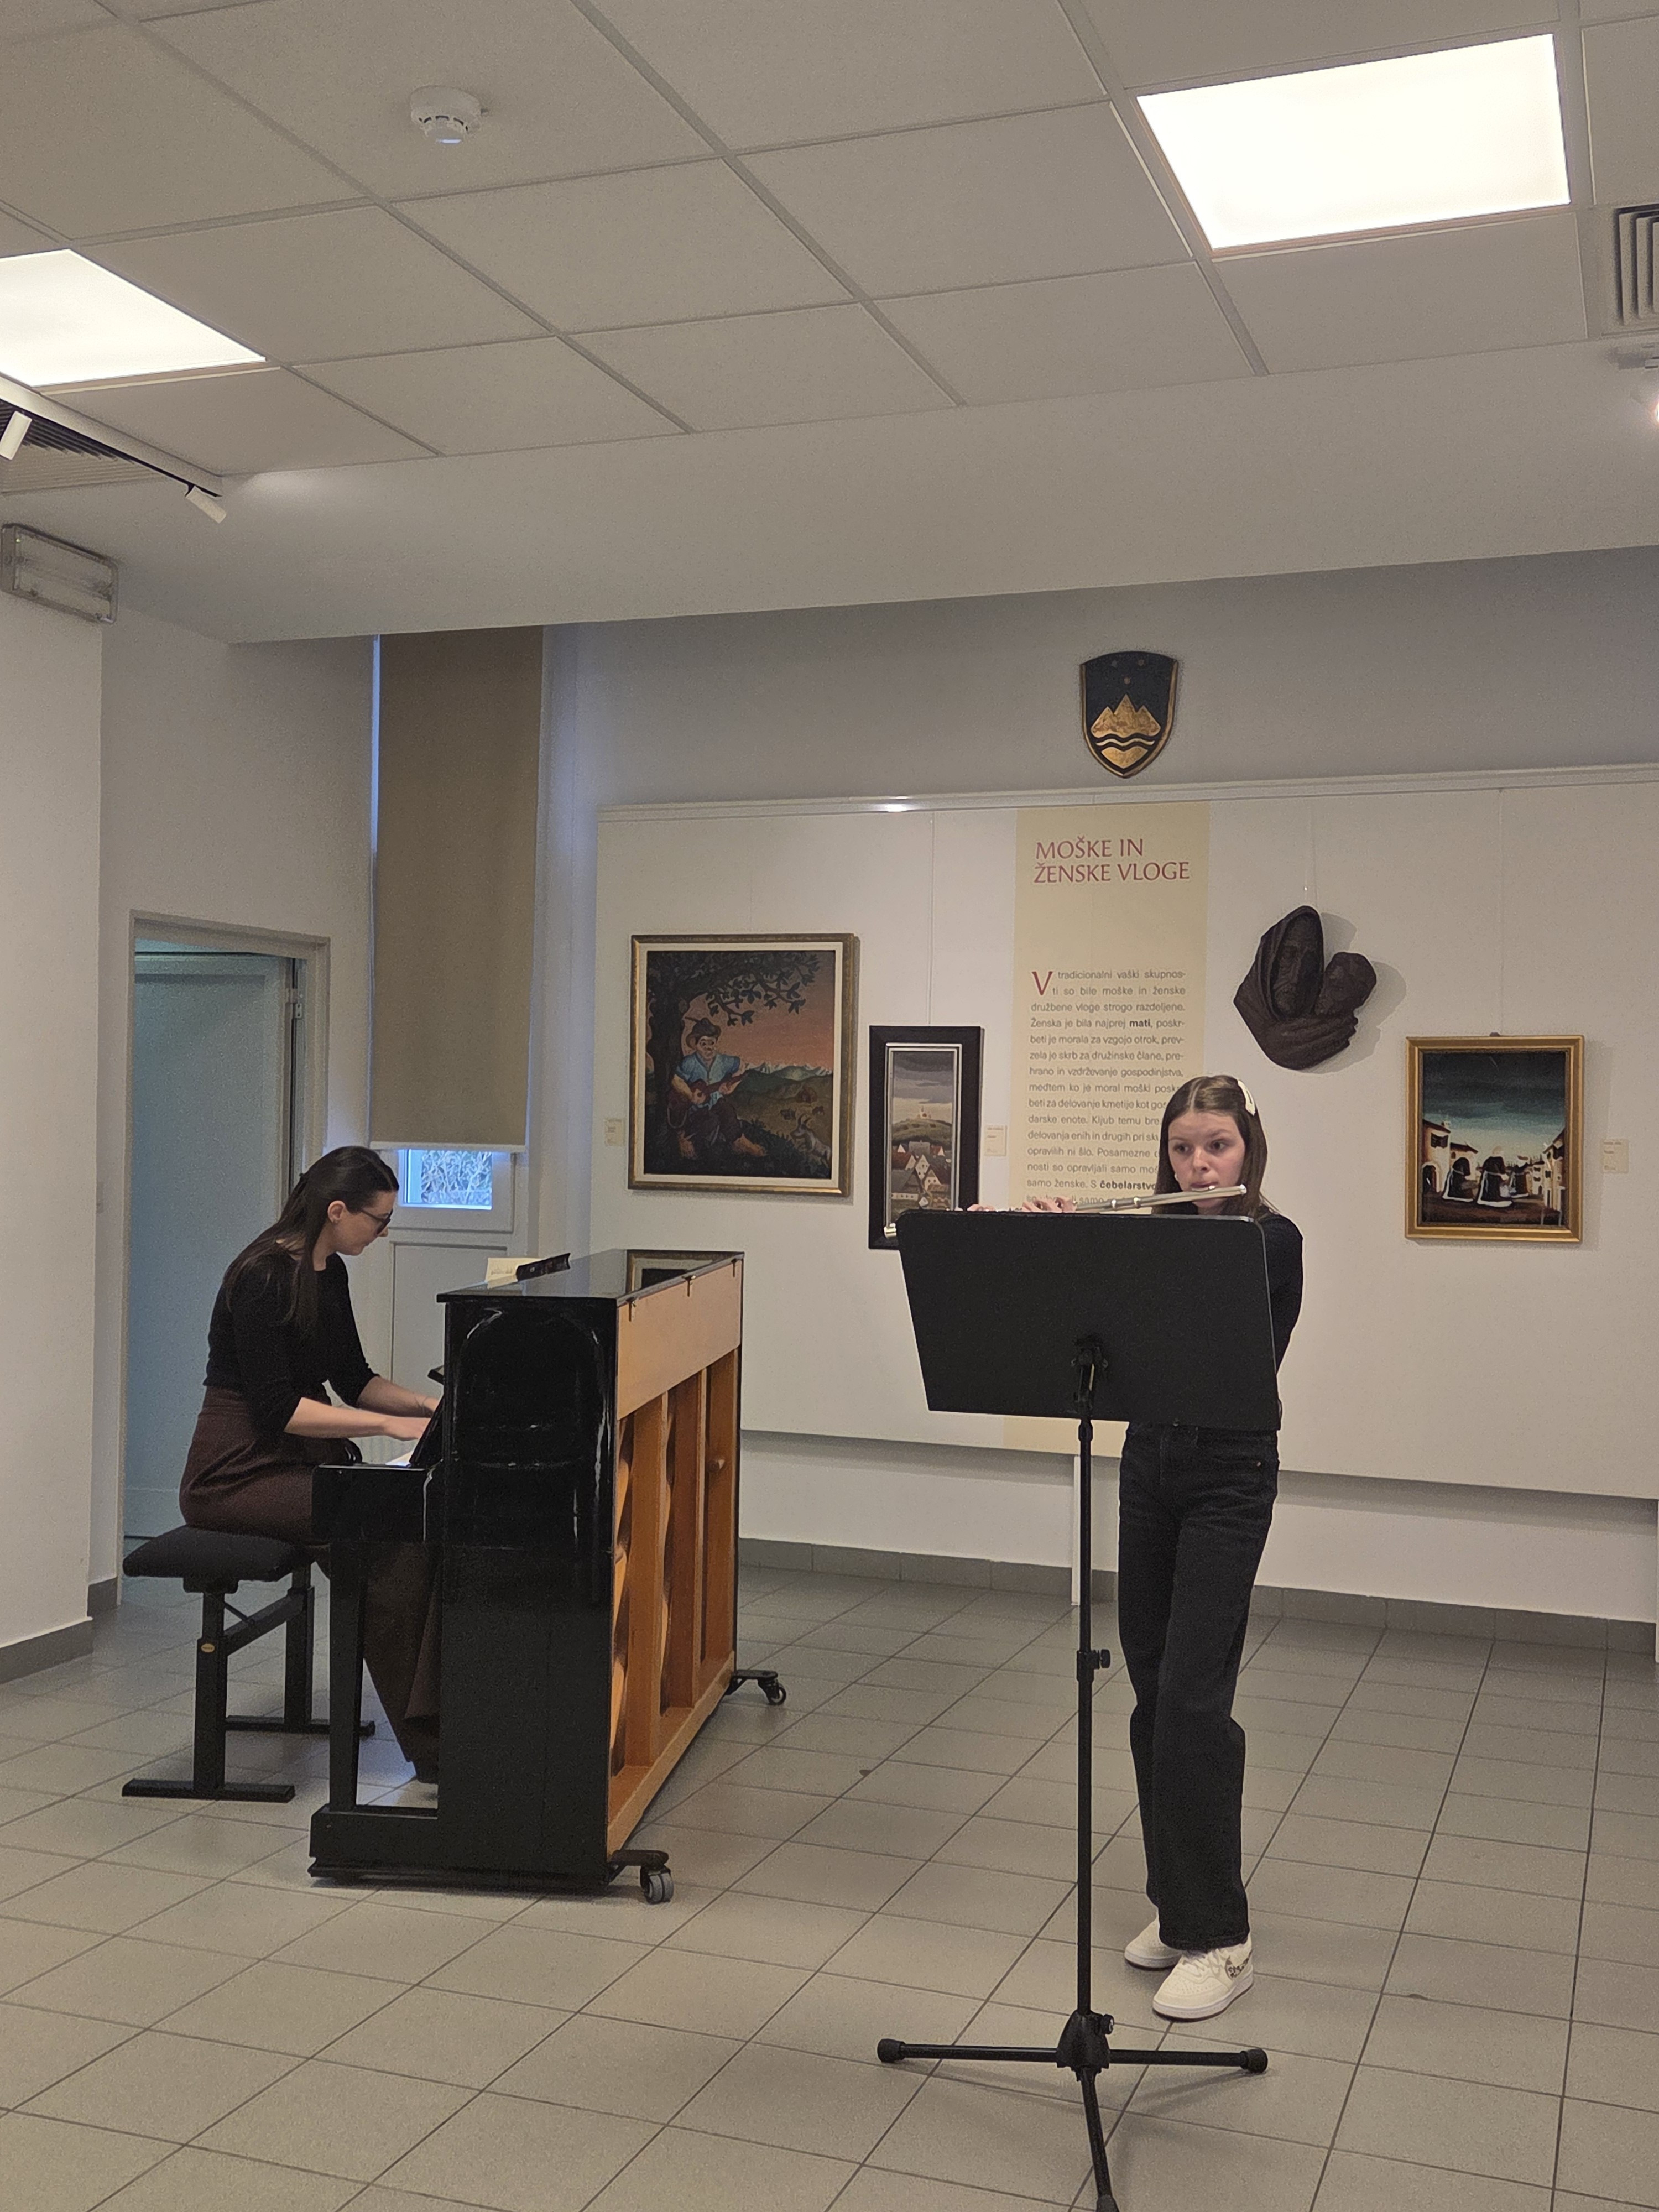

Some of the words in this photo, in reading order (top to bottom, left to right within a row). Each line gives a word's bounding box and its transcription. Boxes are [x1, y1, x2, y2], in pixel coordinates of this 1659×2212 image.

[1036, 836, 1112, 859] MOŠKE
[1120, 839, 1142, 857] IN
[1034, 863, 1111, 883] ŽENSKE
[1117, 862, 1190, 881] VLOGE
[1032, 971, 1053, 995] V
[1144, 972, 1186, 980] skupnos-
[1152, 987, 1185, 995] ženske
[1031, 1003, 1072, 1012] družbene
[1076, 1003, 1100, 1013] vloge
[1103, 1004, 1132, 1013] strogo
[1136, 1003, 1185, 1013] razdeljene.
[1031, 1018, 1061, 1027] Ženska
[1065, 1020, 1073, 1029] je
[1076, 1019, 1092, 1027] bila
[1095, 1020, 1126, 1029] najprej
[1129, 1020, 1153, 1029] mati,
[1156, 1019, 1185, 1029] poskr-
[1048, 1036, 1056, 1045] je
[1103, 1036, 1132, 1045] vzgojo
[1134, 1036, 1159, 1045] otrok,
[1049, 1051, 1057, 1061] je
[1092, 1051, 1134, 1060] družinske
[1068, 1067, 1118, 1077] vzdrževanje
[1029, 1083, 1065, 1092] medtem
[1083, 1084, 1091, 1093] je
[1095, 1084, 1120, 1092] moral
[1124, 1084, 1150, 1092] moški
[1058, 1099, 1100, 1109] delovanje
[1102, 1100, 1134, 1109] kmetije
[1135, 1100, 1149, 1108] kot
[1028, 1115, 1057, 1123] darske
[1092, 1116, 1114, 1126] Kljub
[1145, 1117, 1161, 1125] bre
[1027, 1131, 1070, 1141] delovanja
[1071, 1131, 1089, 1140] enih
[1102, 1132, 1131, 1142] drugih
[1133, 1133, 1144, 1142] pri
[1027, 1147, 1063, 1157] opravilih
[1097, 1148, 1150, 1157] Posamezne
[1027, 1163, 1048, 1171] nosti
[1067, 1164, 1107, 1174] opravljali
[1054, 1179, 1088, 1188] ženske.
